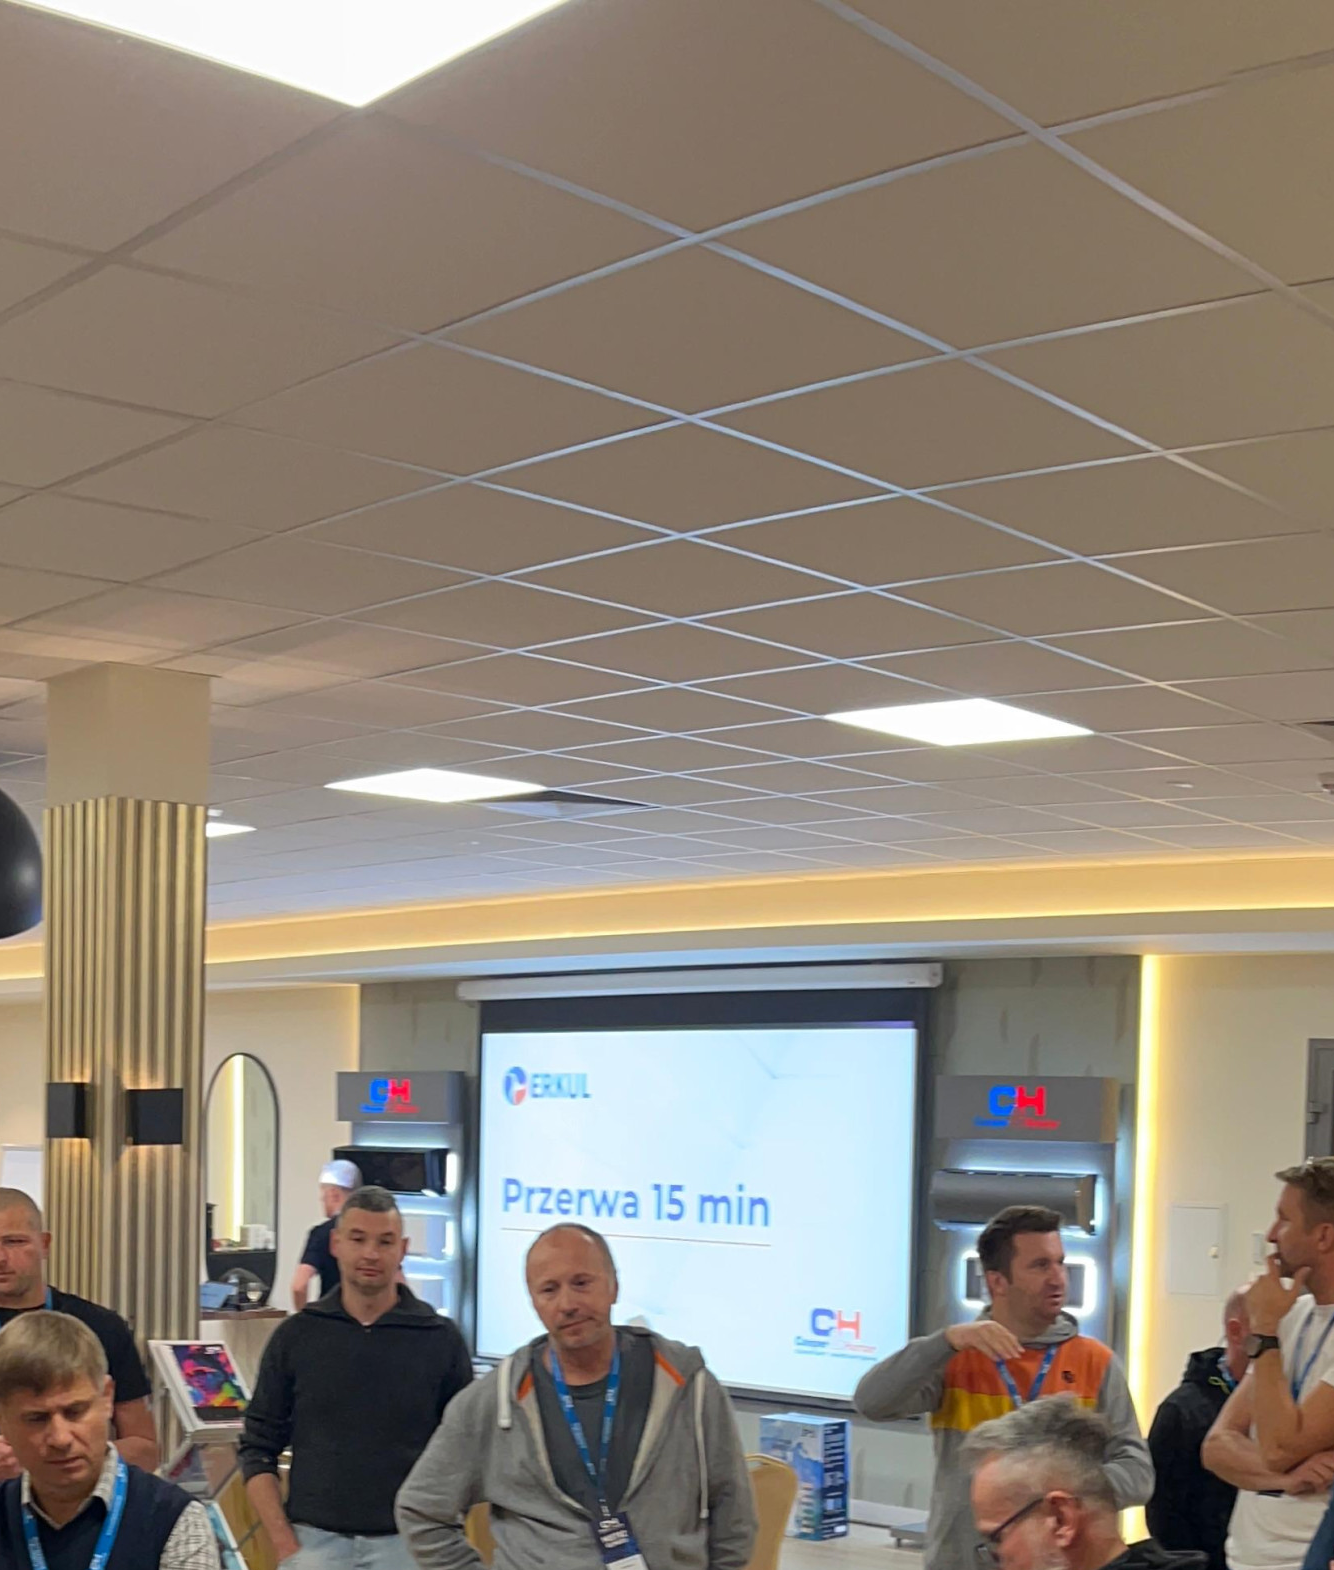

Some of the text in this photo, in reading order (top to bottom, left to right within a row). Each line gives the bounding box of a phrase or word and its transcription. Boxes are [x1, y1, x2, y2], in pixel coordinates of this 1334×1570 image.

[369, 1079, 410, 1104] CH
[989, 1085, 1046, 1116] CH
[501, 1177, 771, 1226] Przerwa 15 min
[811, 1308, 861, 1339] CH
